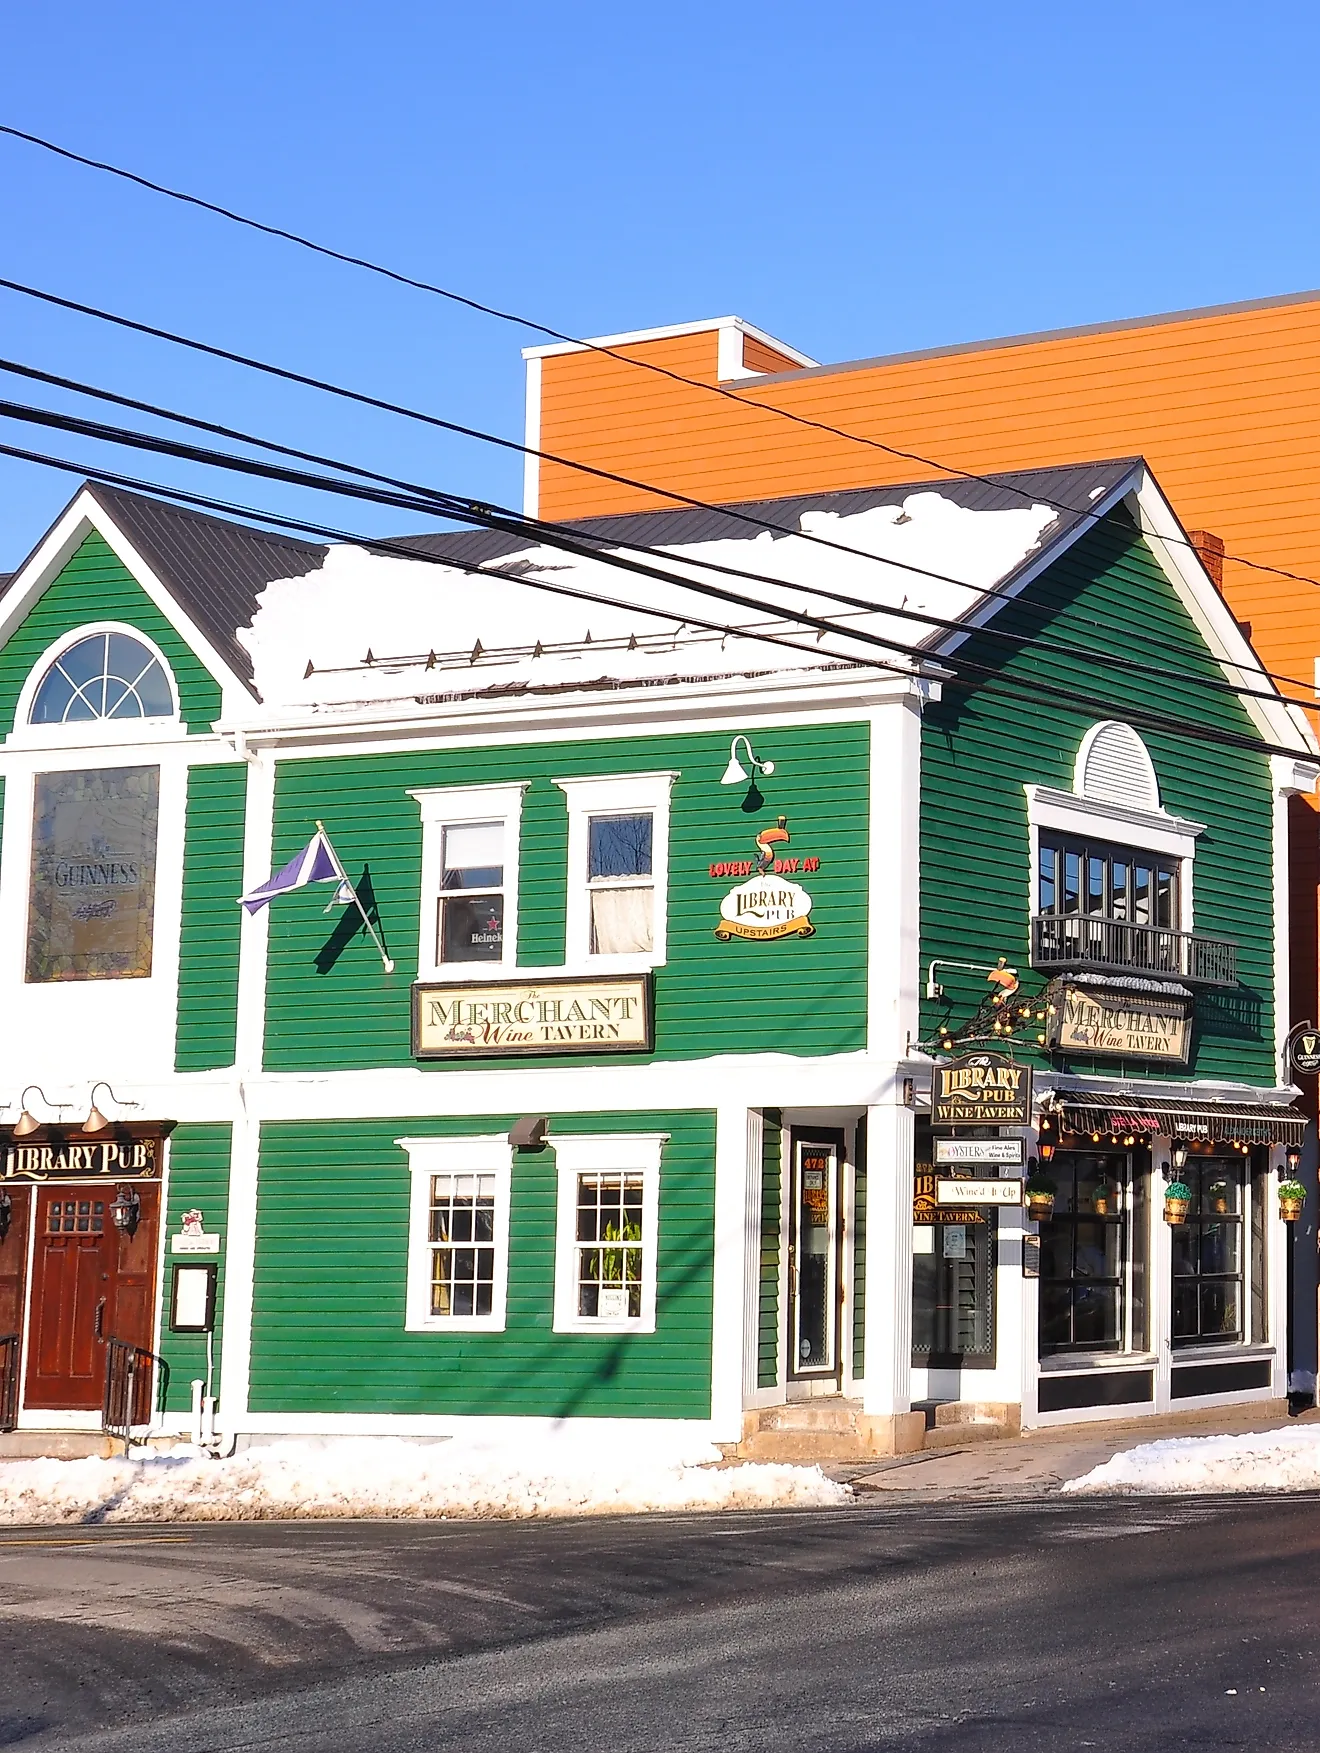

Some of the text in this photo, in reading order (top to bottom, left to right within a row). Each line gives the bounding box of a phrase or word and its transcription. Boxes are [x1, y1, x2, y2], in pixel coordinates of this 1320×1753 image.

[709, 857, 820, 877] LOVELY DAY AT
[55, 861, 138, 887] GUINNESS
[736, 890, 796, 918] LIBRARY
[766, 909, 795, 920] PUB
[735, 925, 788, 937] UPSTAIRS
[471, 932, 503, 944] Heinek
[520, 990, 541, 1000] The
[427, 996, 638, 1027] MERCHANT
[1063, 1000, 1181, 1036] MERCHANT
[473, 1019, 620, 1045] Wine TAVERN
[1088, 1024, 1171, 1052] Wine TAVERN
[967, 1056, 991, 1067] The
[940, 1067, 1022, 1101] LIBRARY
[983, 1089, 1016, 1102] PUB
[937, 1105, 1025, 1119] WINE TAVERN
[1175, 1122, 1208, 1134] LIBRARY PUB
[947, 1145, 985, 1157] OYSTERS
[5, 1143, 148, 1181] LIBRARY PUB
[804, 1158, 825, 1169] 472
[938, 1211, 975, 1221] TAVERN
